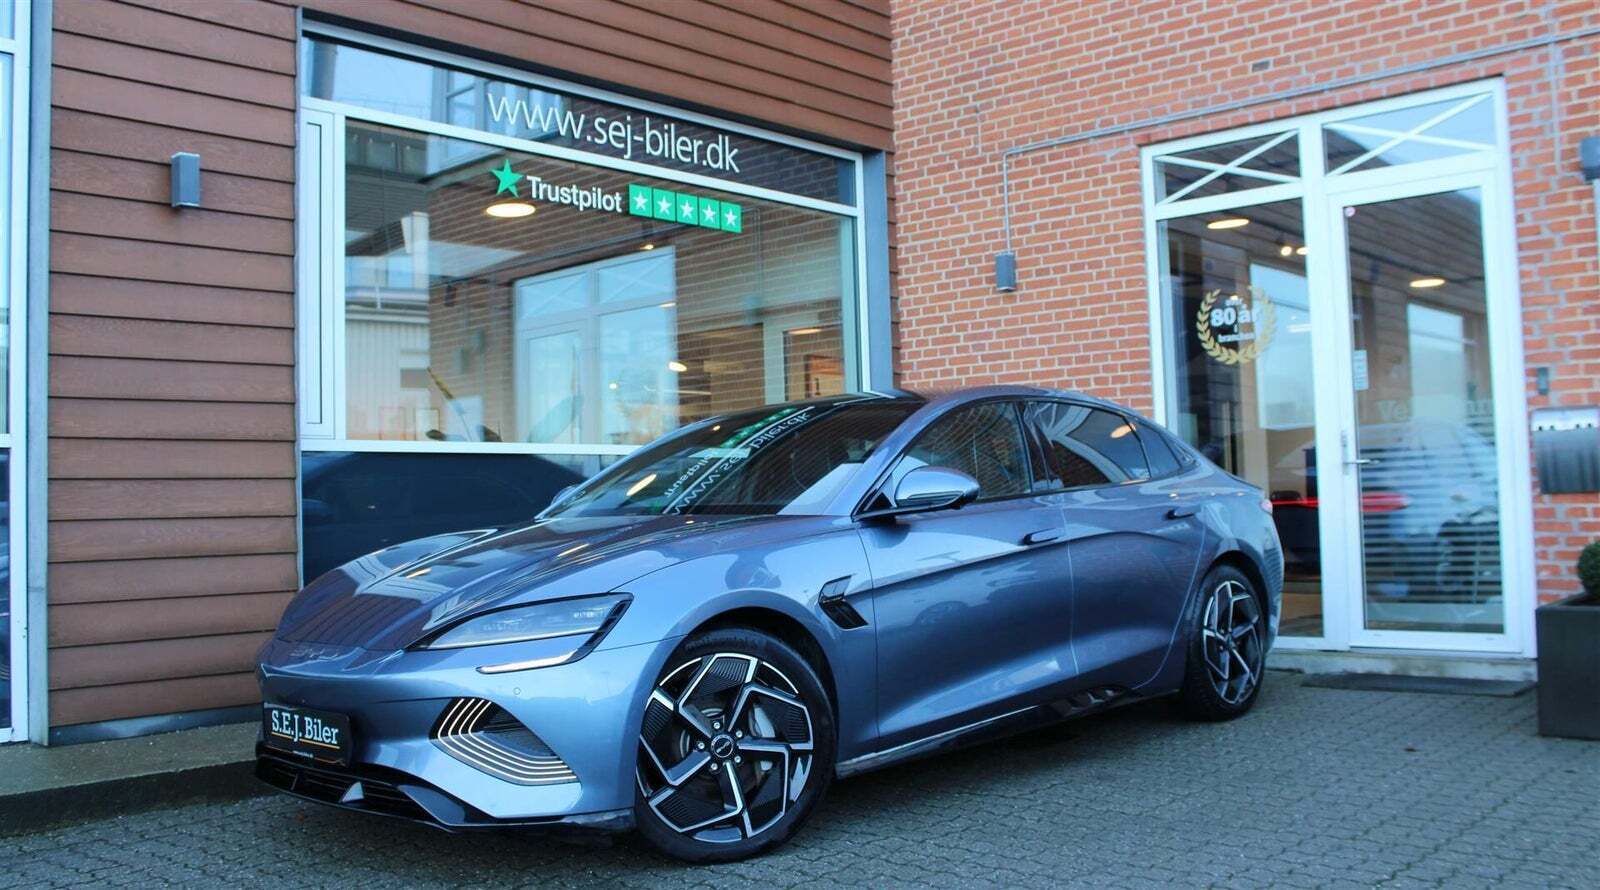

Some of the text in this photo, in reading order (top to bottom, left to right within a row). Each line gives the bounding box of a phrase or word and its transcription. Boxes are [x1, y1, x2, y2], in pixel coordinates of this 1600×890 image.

[488, 93, 740, 173] www.sej-biler.dk
[527, 175, 622, 213] Trustpilot
[1210, 307, 1236, 327] 80
[271, 709, 339, 745] S.E.J. Biler
